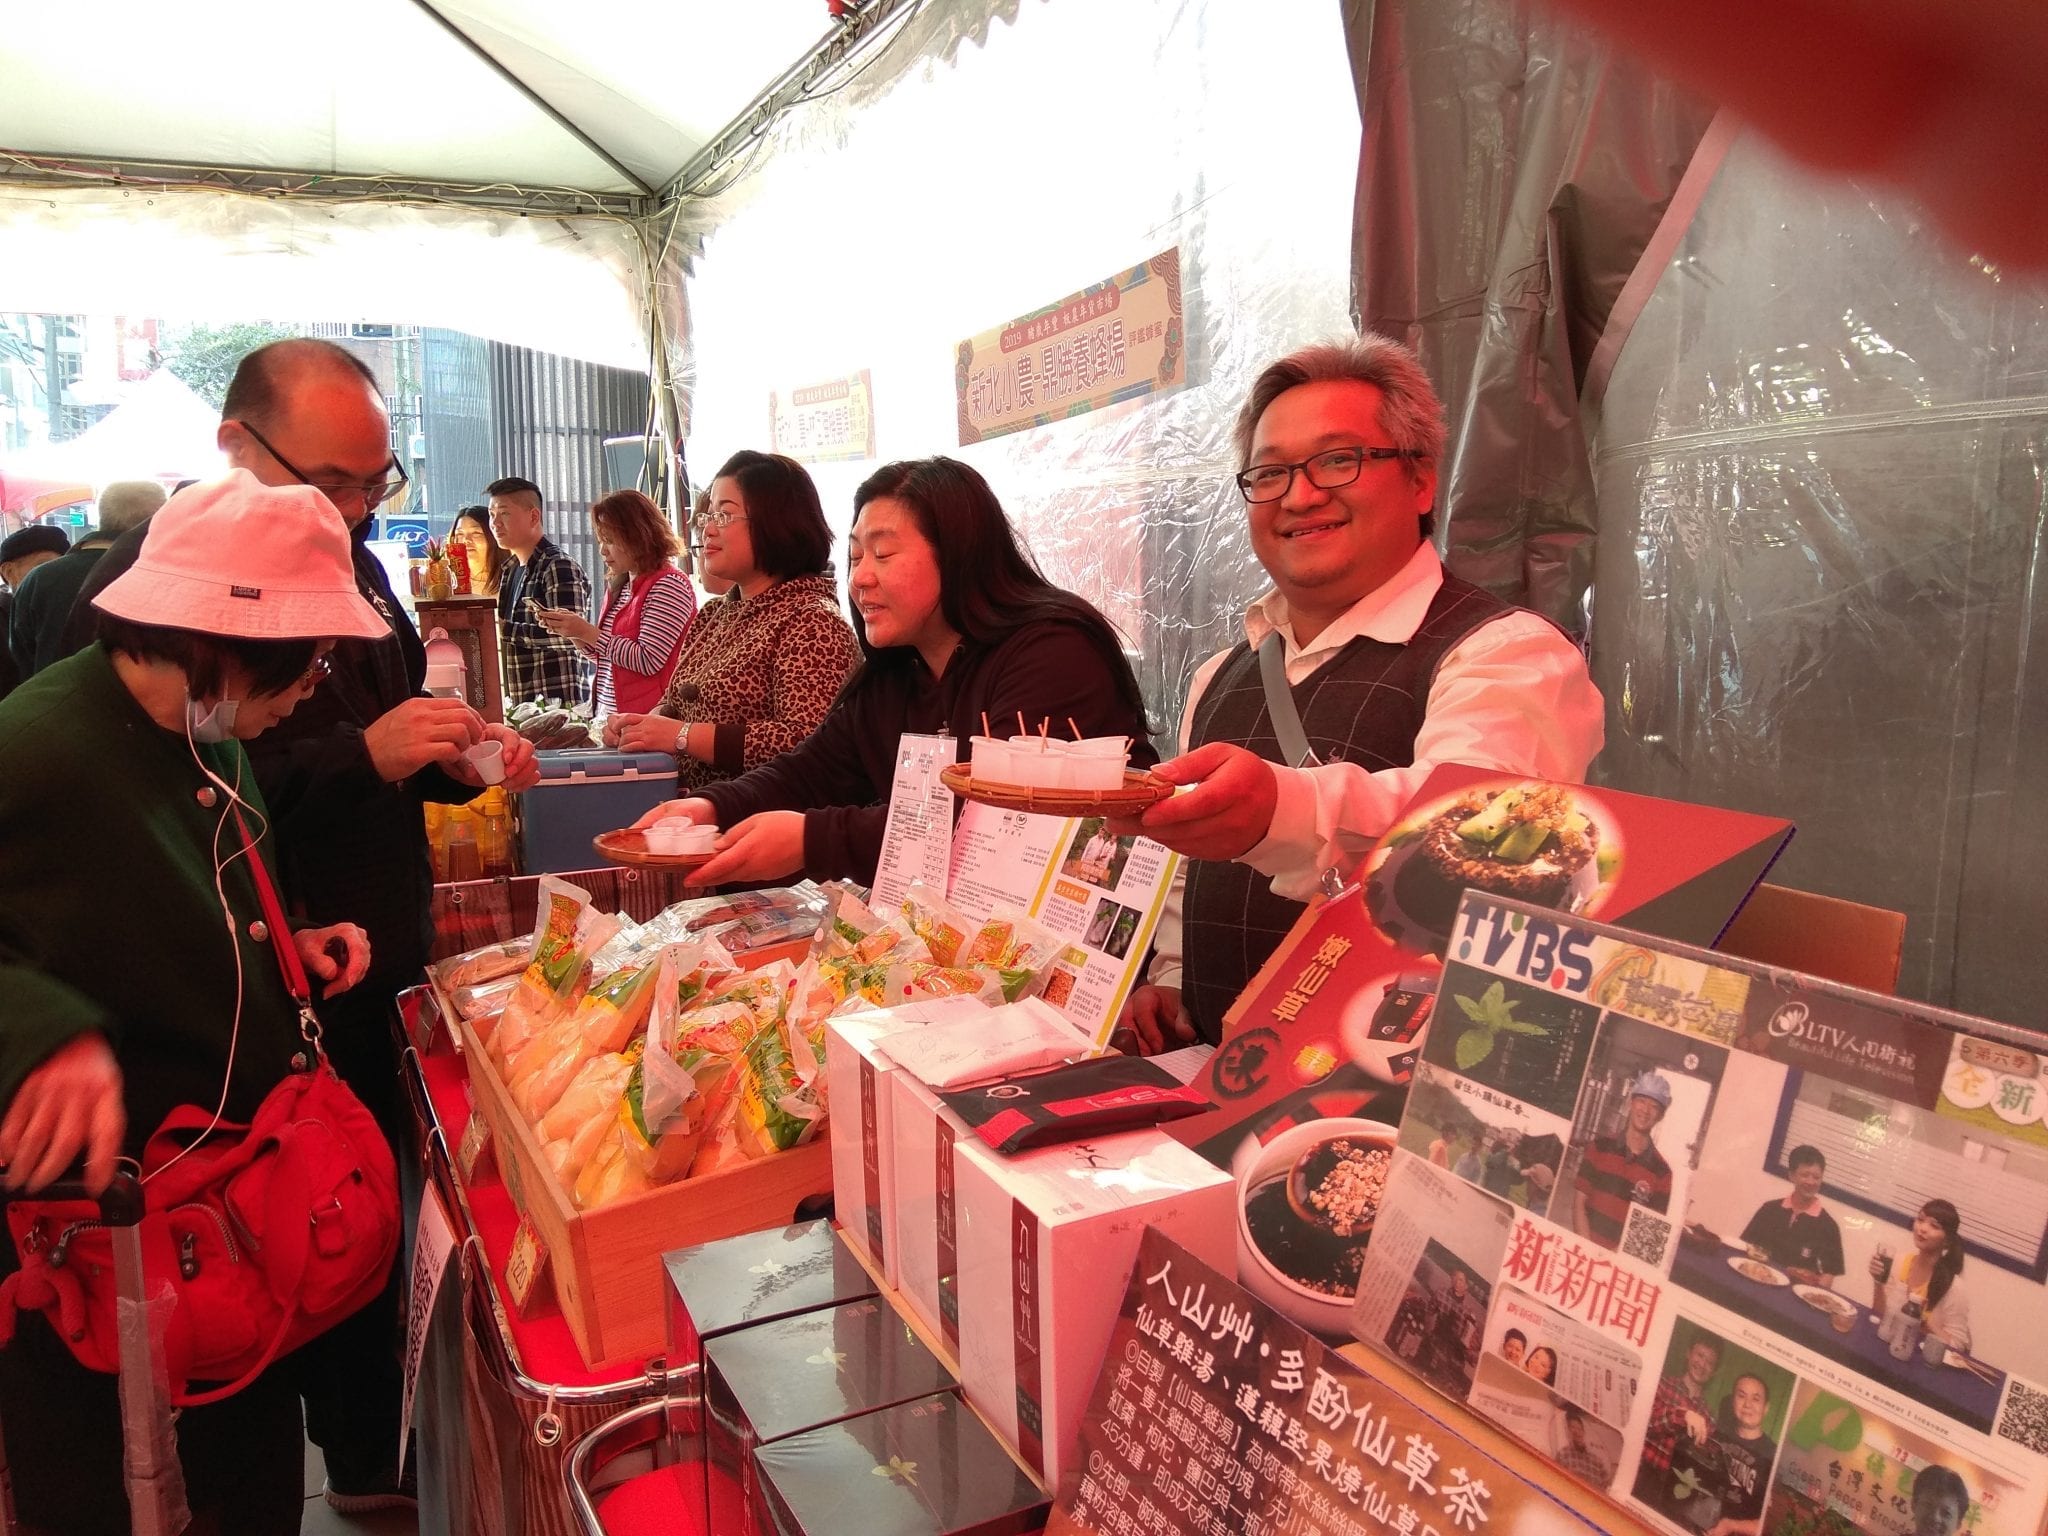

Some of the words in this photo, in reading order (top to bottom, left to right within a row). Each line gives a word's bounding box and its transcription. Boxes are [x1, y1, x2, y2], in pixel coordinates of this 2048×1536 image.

[1004, 332, 1022, 348] 2019
[393, 531, 425, 541] HCT
[1272, 934, 1353, 1022] 嫩仙草
[1460, 900, 1597, 993] TVBS
[1975, 1046, 2032, 1069] 第六季
[1503, 1218, 1662, 1348] 新新聞
[1818, 1367, 1835, 1379] with
[1135, 1303, 1440, 1536] 仙草雞湯、蓮藕堅果燒仙草
[1101, 1418, 1237, 1536] 45分鐘，即成天然美
